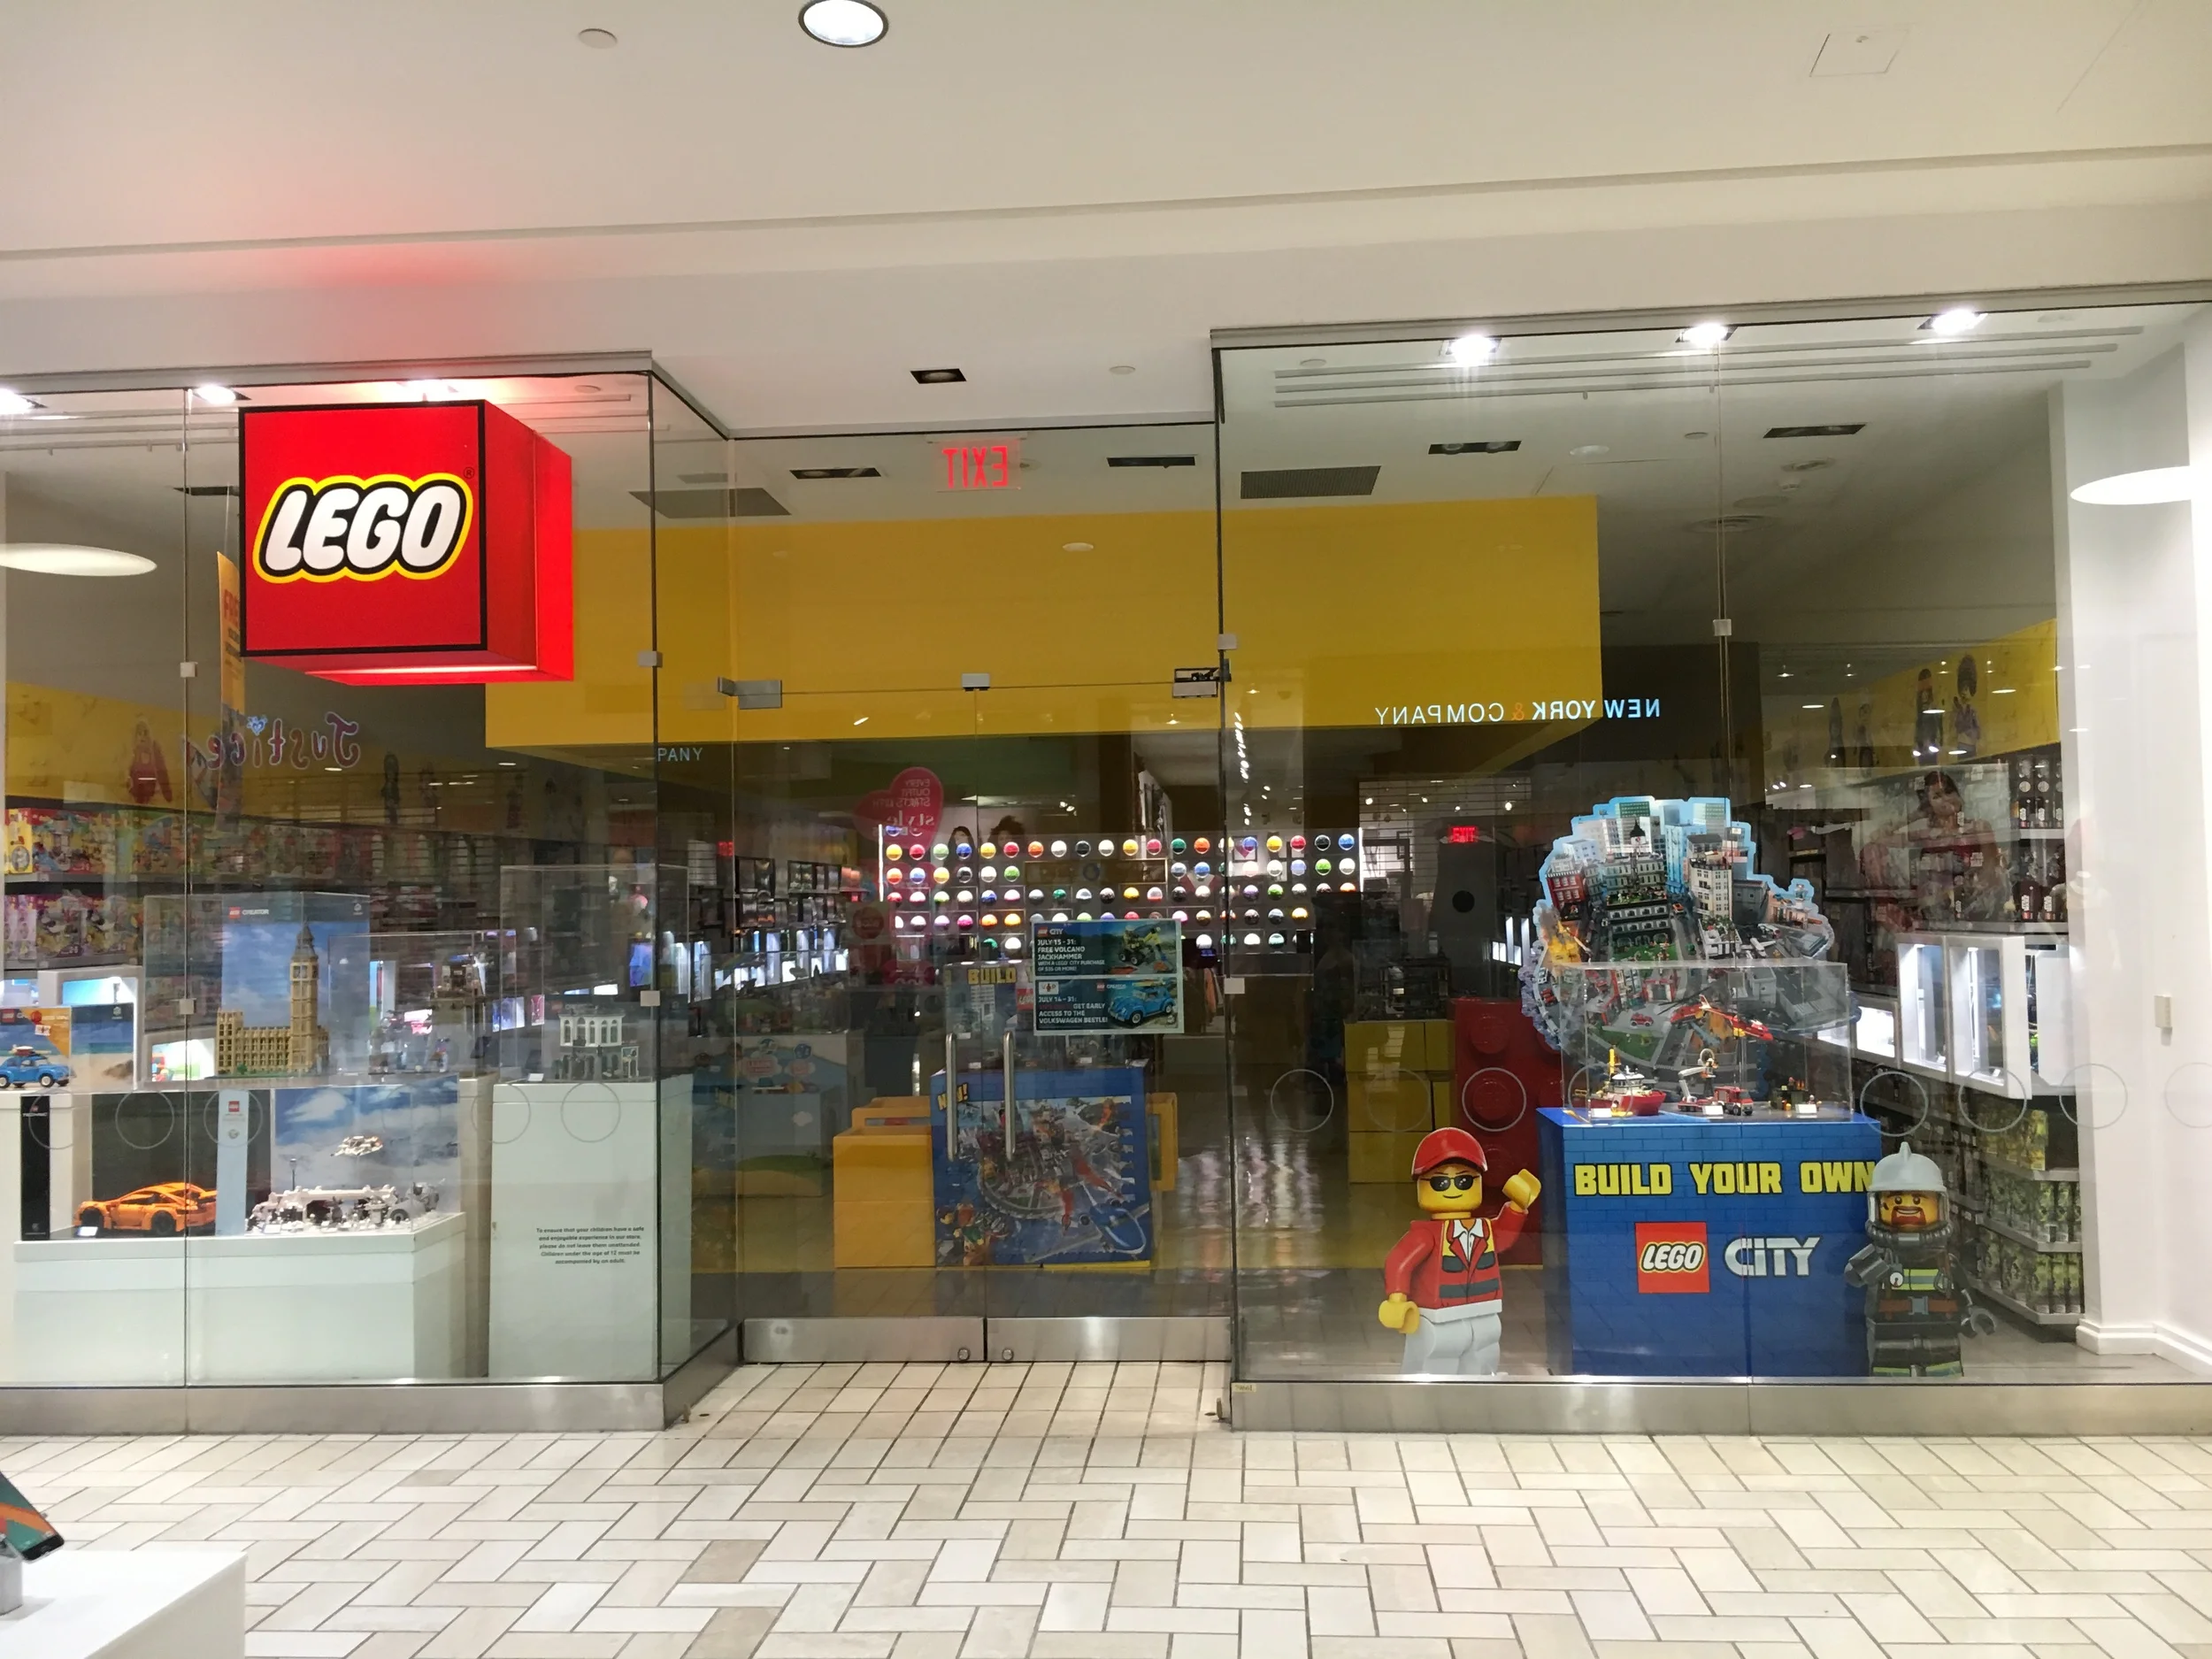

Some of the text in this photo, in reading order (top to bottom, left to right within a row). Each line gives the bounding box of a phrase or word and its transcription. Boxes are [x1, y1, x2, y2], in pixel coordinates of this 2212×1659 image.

[258, 478, 467, 579] LEGO
[967, 967, 1017, 985] BUILD
[938, 1084, 968, 1110] NW!
[1574, 1161, 1876, 1195] BUILD YOUR OWN
[1640, 1237, 1820, 1276] LEGO CITY
